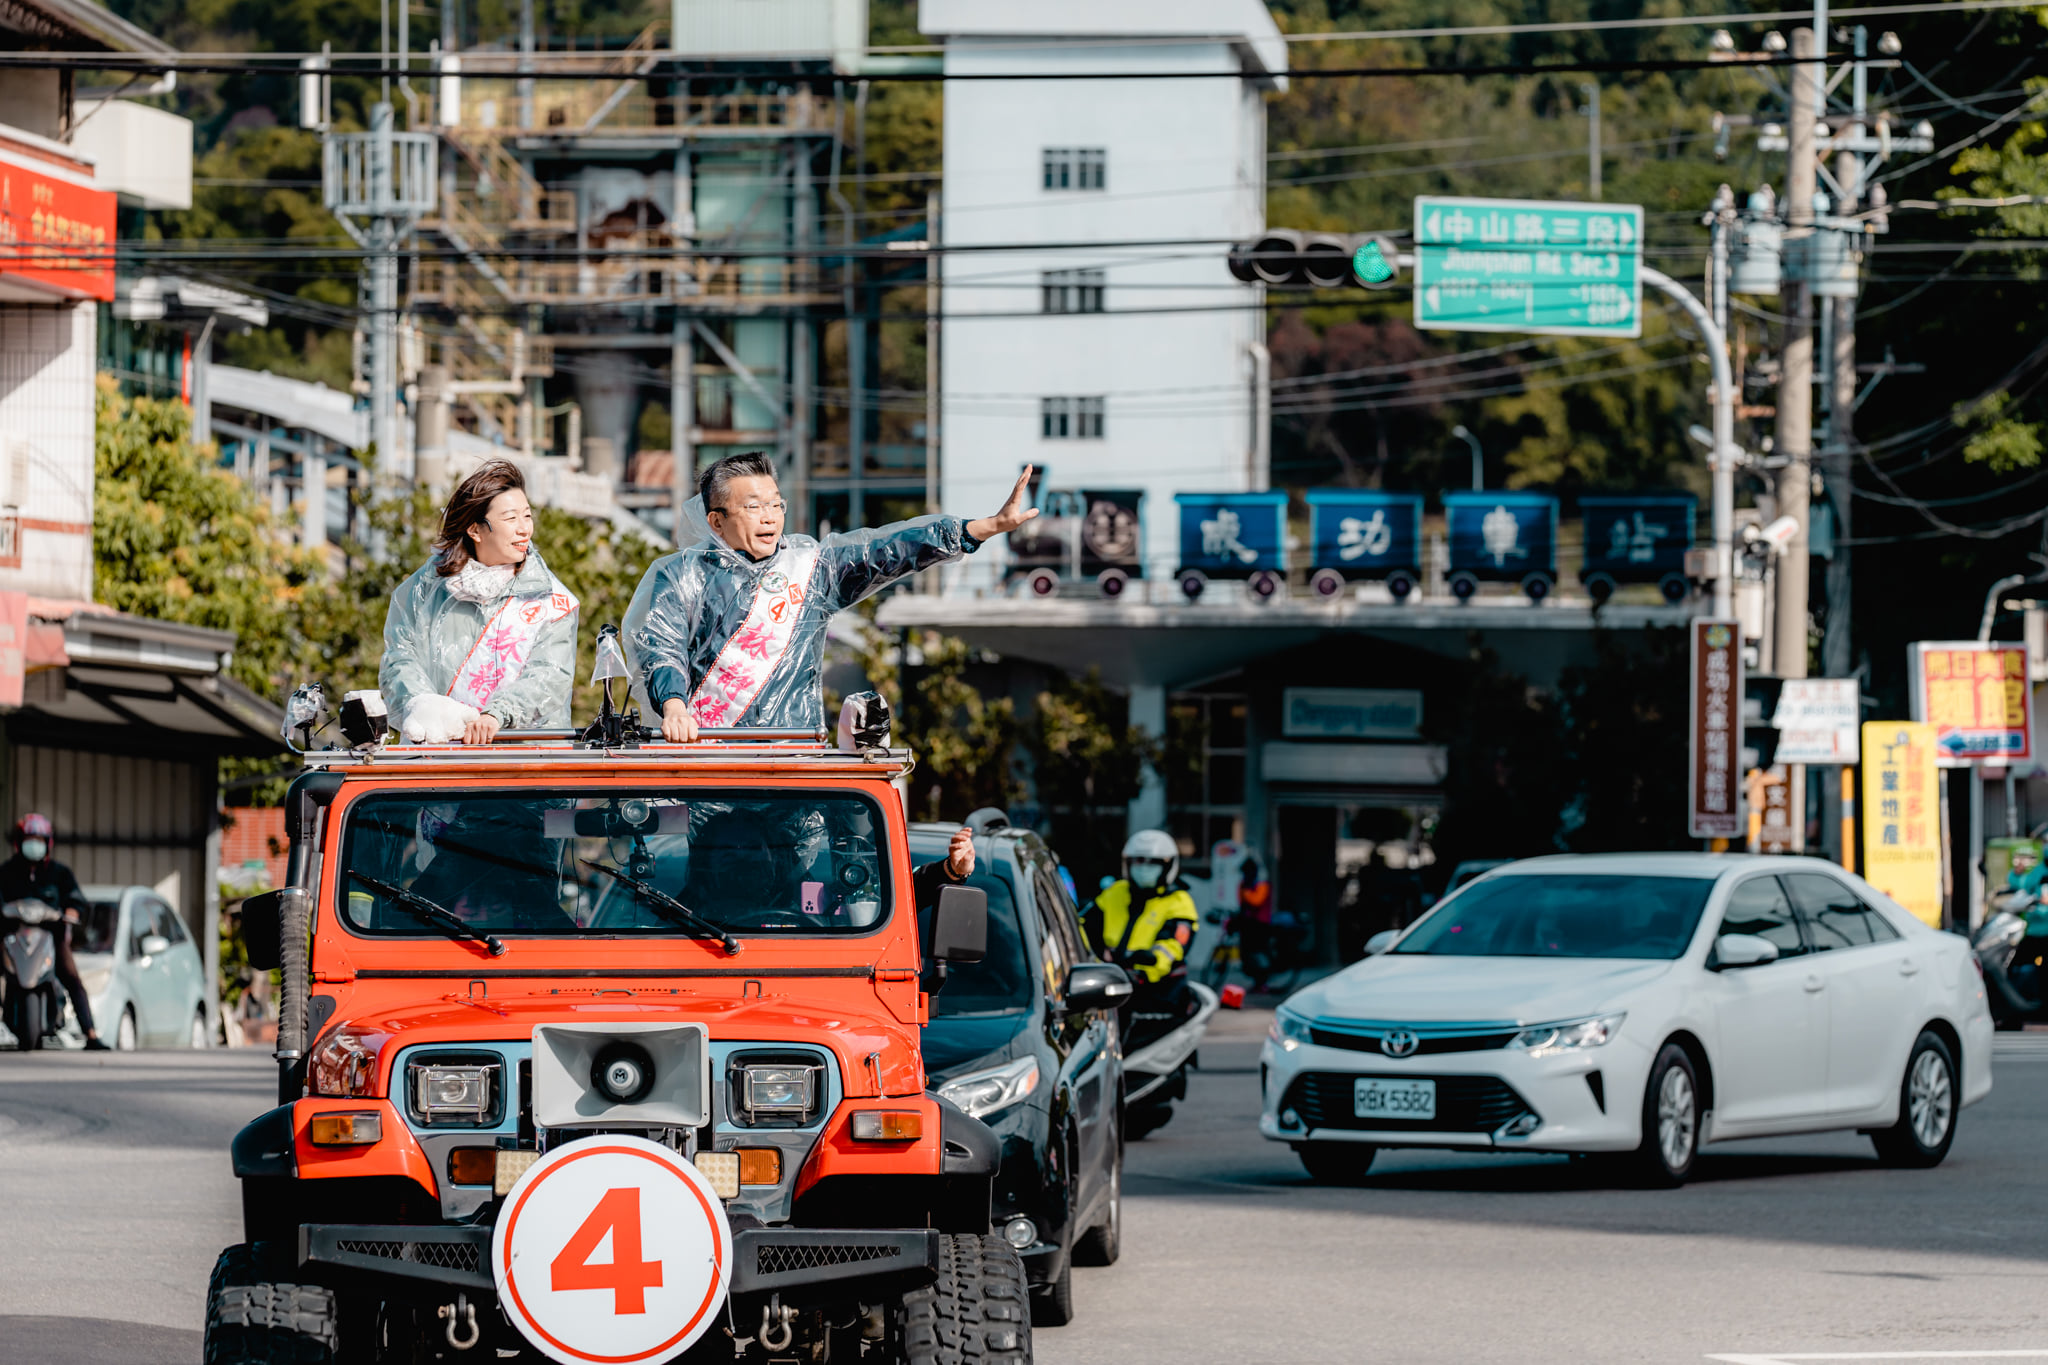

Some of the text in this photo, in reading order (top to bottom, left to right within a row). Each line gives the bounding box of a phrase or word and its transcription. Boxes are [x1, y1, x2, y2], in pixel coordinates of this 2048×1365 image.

[1443, 208, 1618, 249] 中山路三段
[521, 604, 542, 623] 4
[771, 601, 786, 621] 4
[461, 624, 528, 712] 林靜
[550, 1186, 664, 1315] 4
